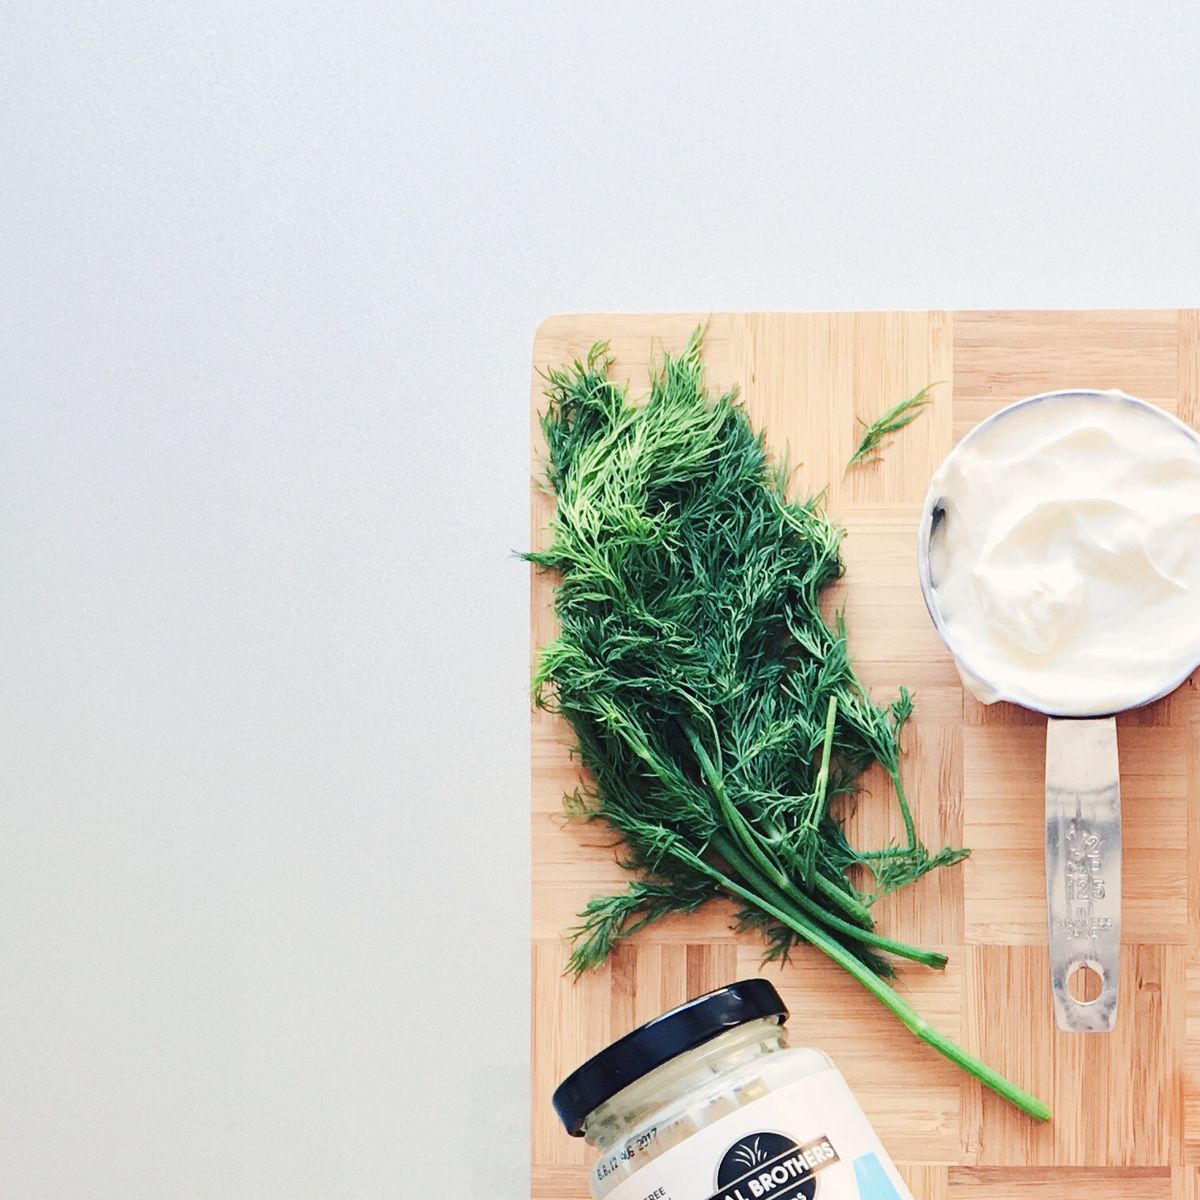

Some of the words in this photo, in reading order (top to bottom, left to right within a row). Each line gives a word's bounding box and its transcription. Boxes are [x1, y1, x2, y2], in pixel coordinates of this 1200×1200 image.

[1067, 878, 1106, 900] 125
[636, 1127, 658, 1151] 2017
[747, 1141, 836, 1199] BROTHERS
